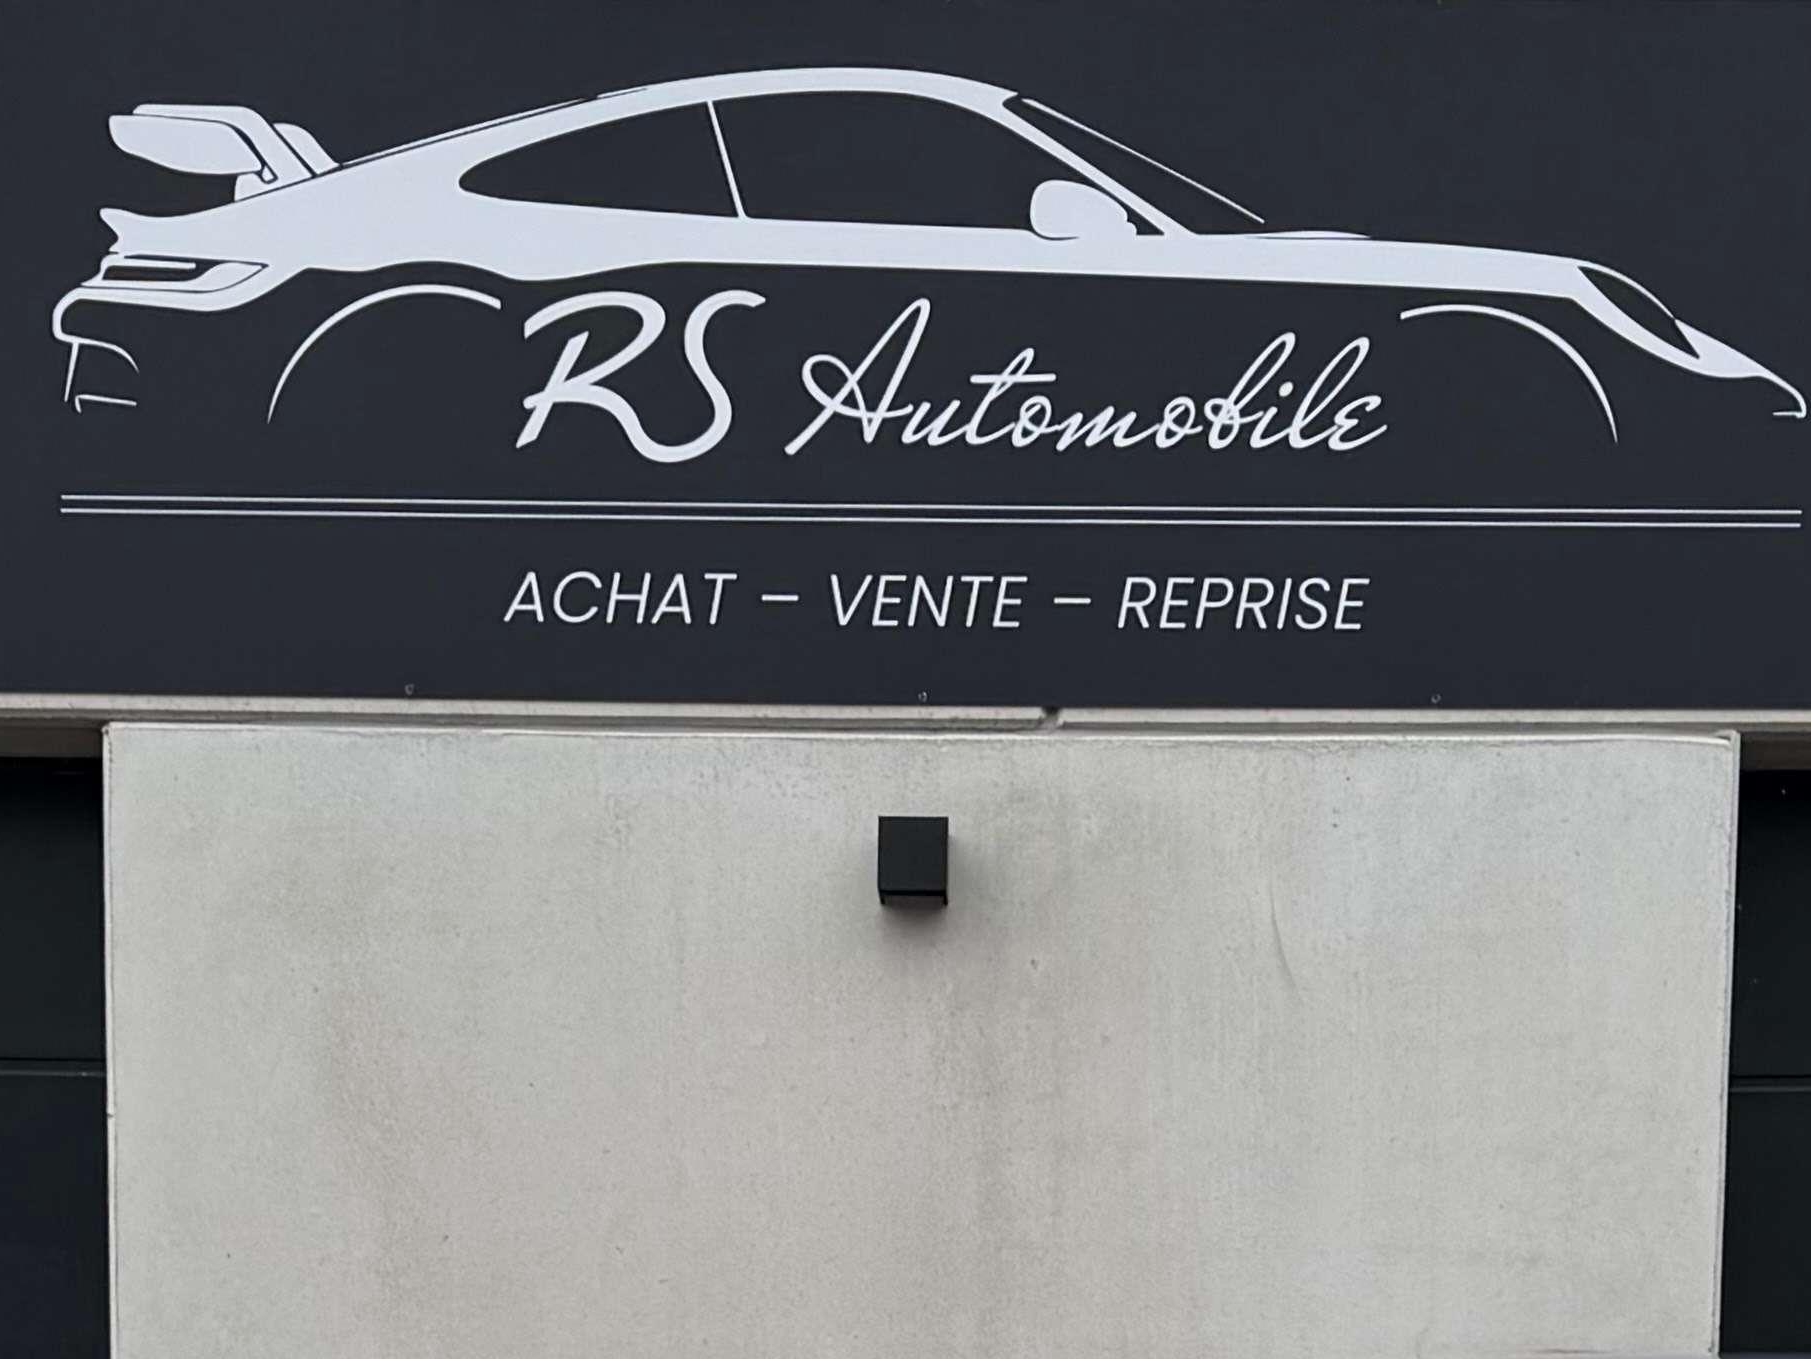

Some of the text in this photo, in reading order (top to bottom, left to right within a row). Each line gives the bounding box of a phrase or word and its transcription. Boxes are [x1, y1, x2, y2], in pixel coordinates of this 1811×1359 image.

[515, 289, 1389, 463] RS Automobile
[503, 570, 739, 625] ACHAT
[830, 573, 1028, 628] VENTE
[1117, 576, 1371, 630] REPRISE
